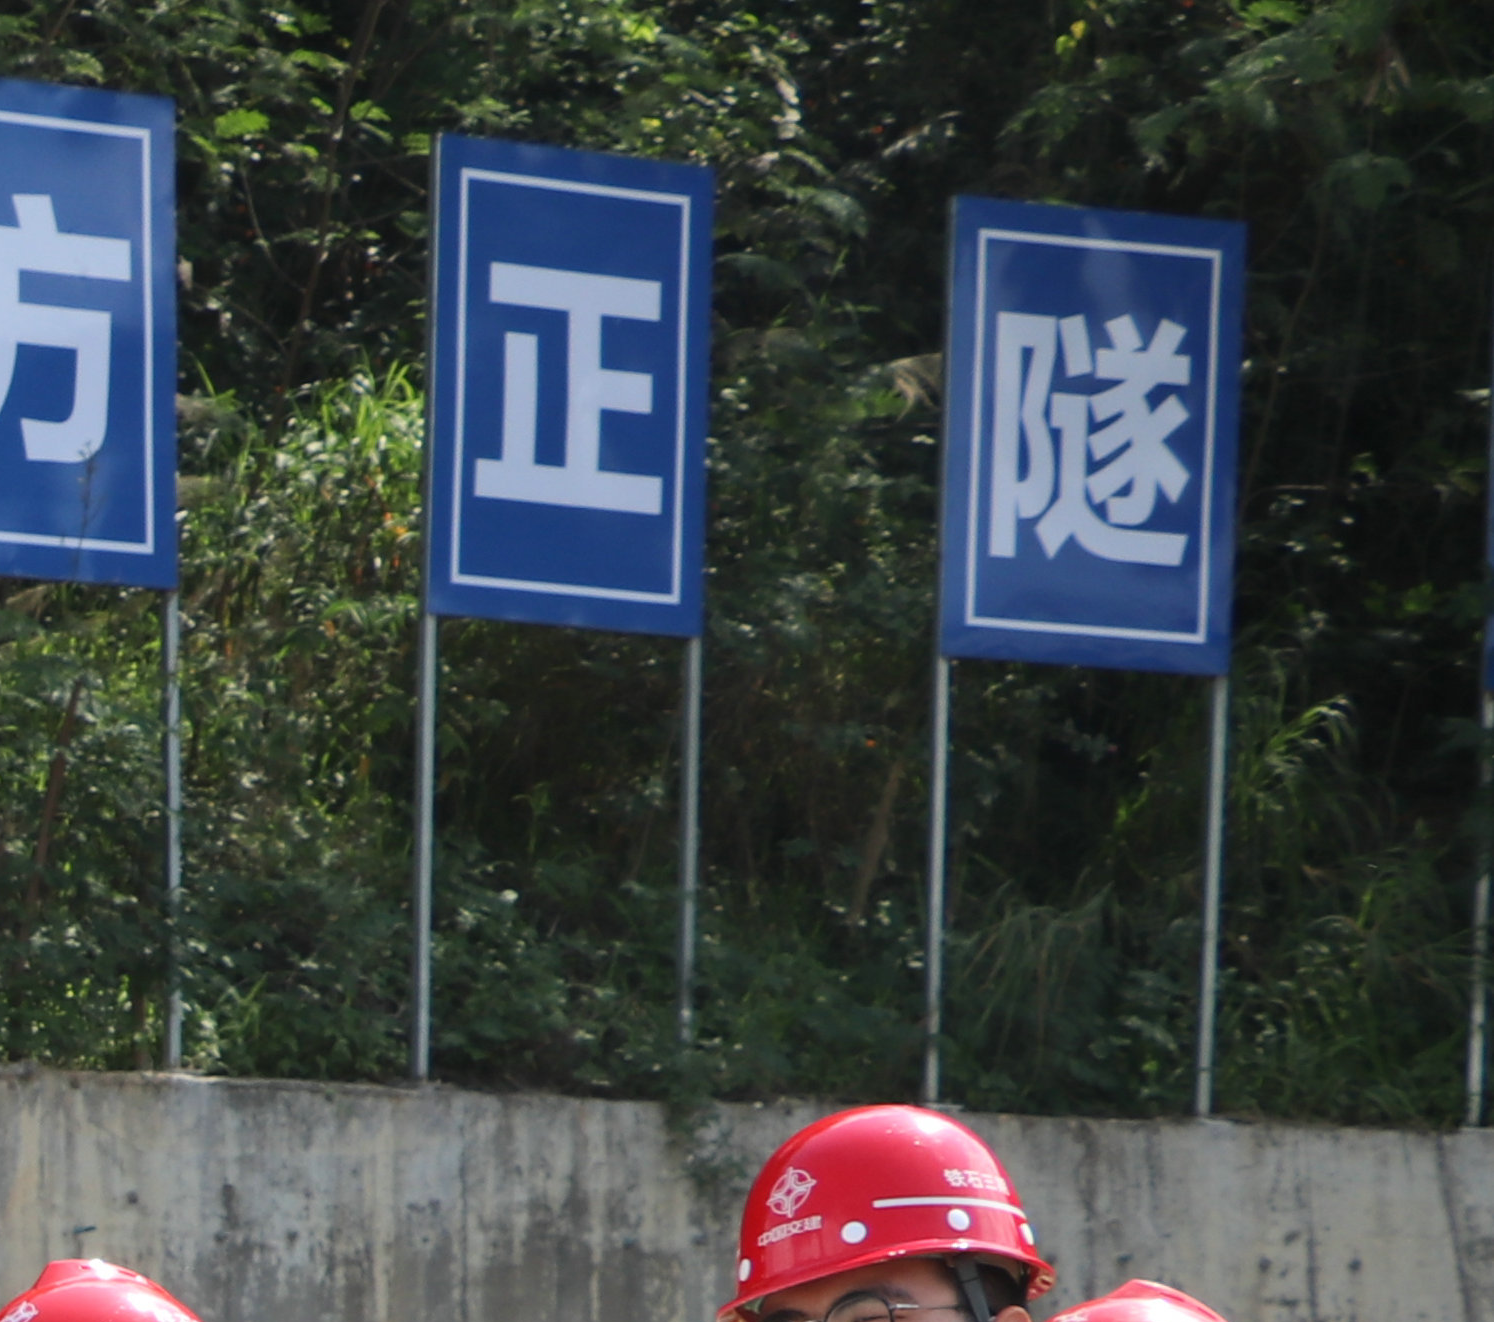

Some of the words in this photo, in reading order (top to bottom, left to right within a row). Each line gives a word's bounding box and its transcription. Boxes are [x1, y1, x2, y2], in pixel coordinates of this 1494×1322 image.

[473, 260, 663, 516] 正
[989, 309, 1192, 568] 隧
[758, 1215, 822, 1247] 中国交建
